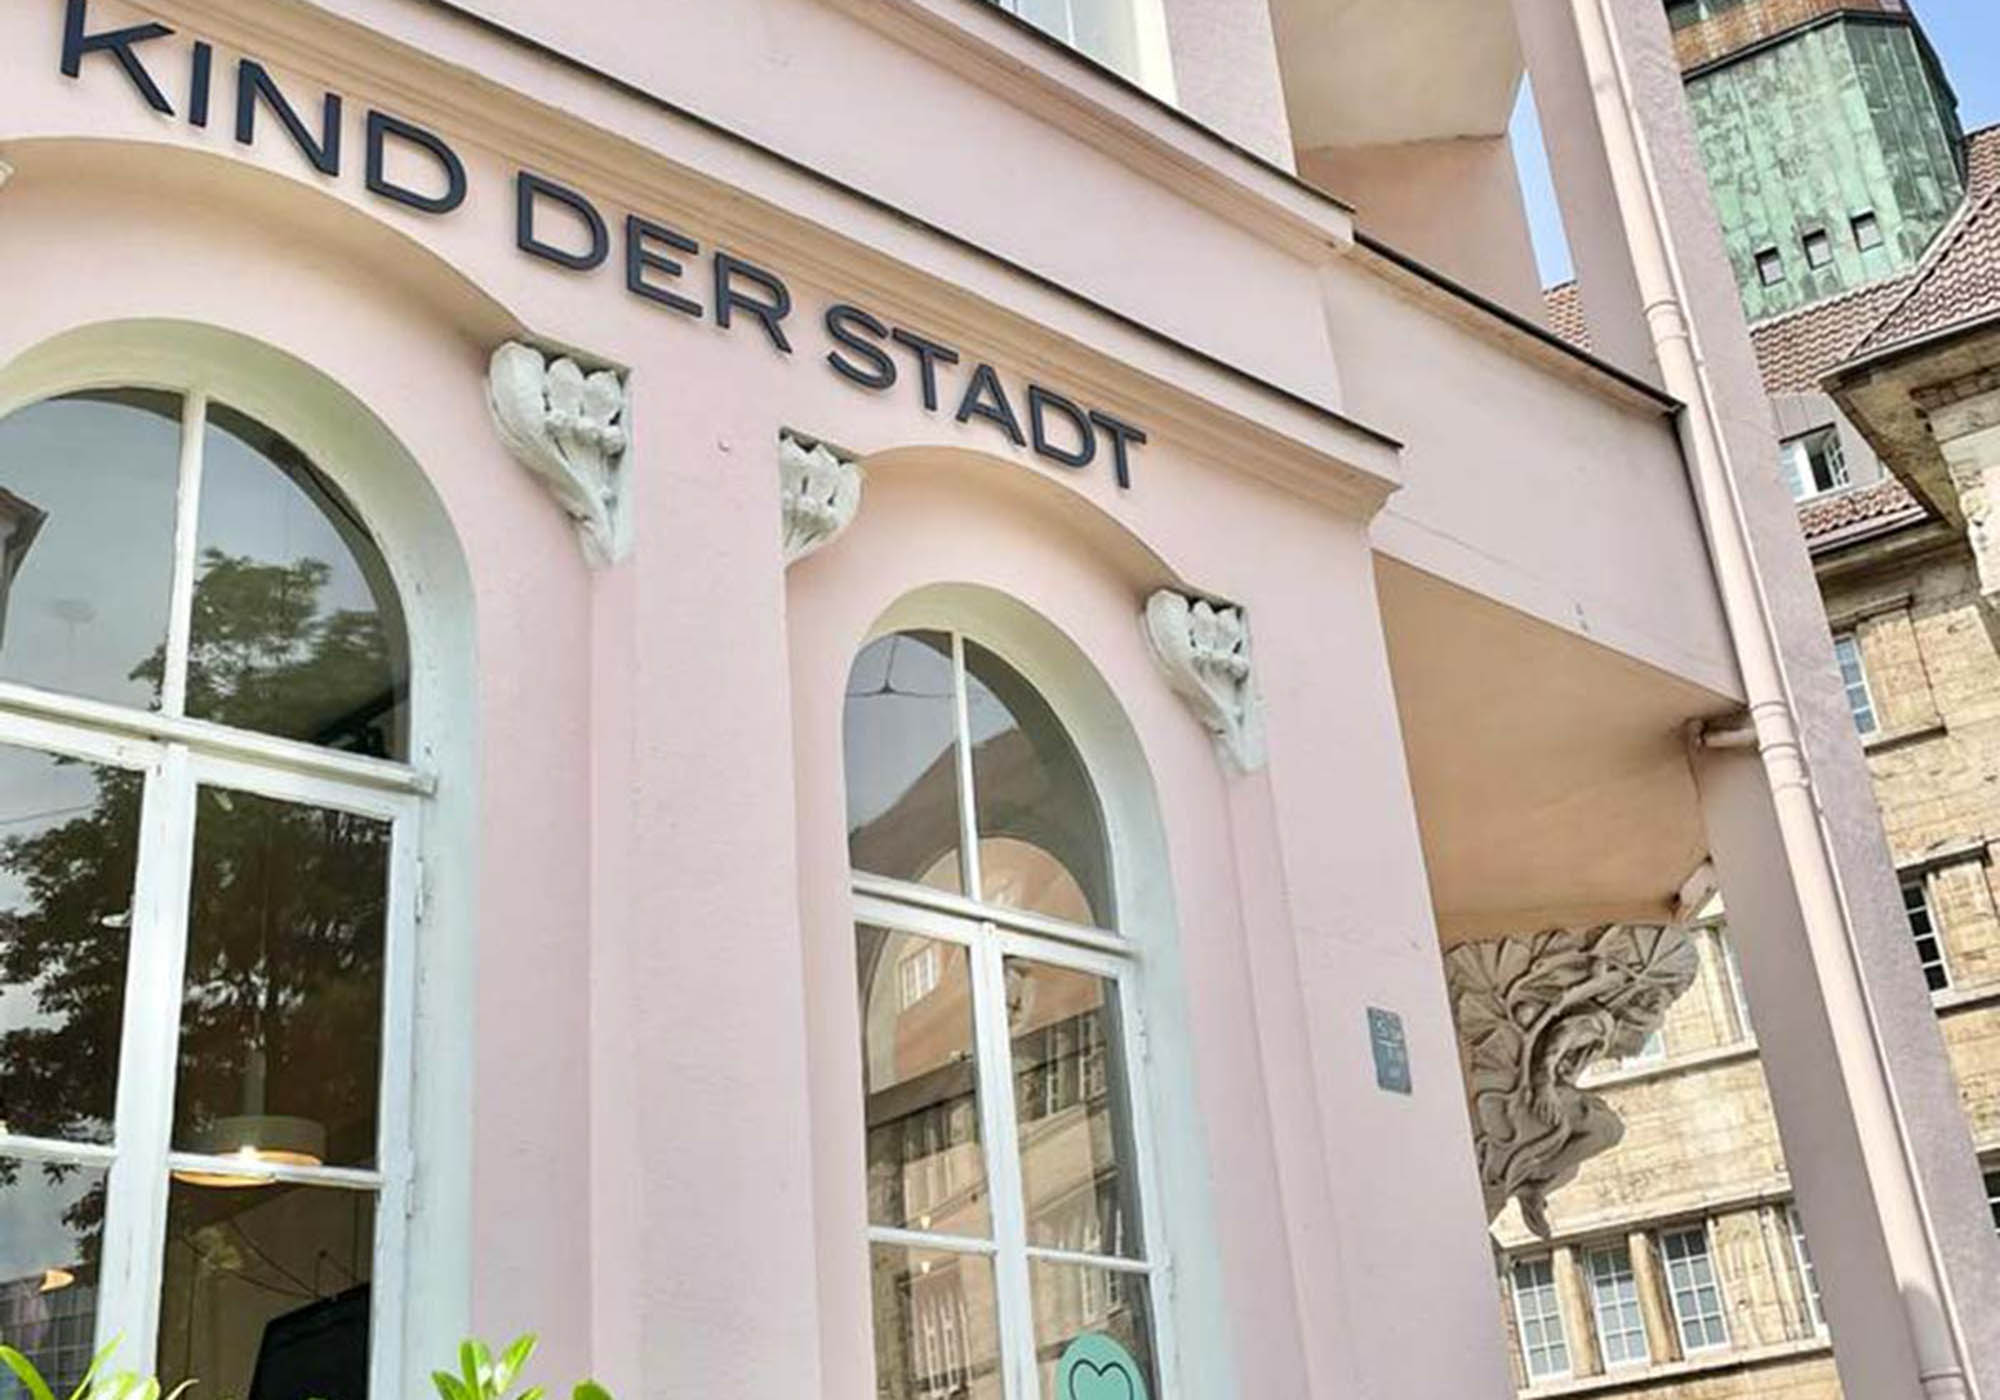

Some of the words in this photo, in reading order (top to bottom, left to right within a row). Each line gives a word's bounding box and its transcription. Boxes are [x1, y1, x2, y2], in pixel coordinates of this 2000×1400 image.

[60, 0, 468, 215] KIND
[516, 170, 793, 355] DER
[825, 304, 1147, 489] STADT
